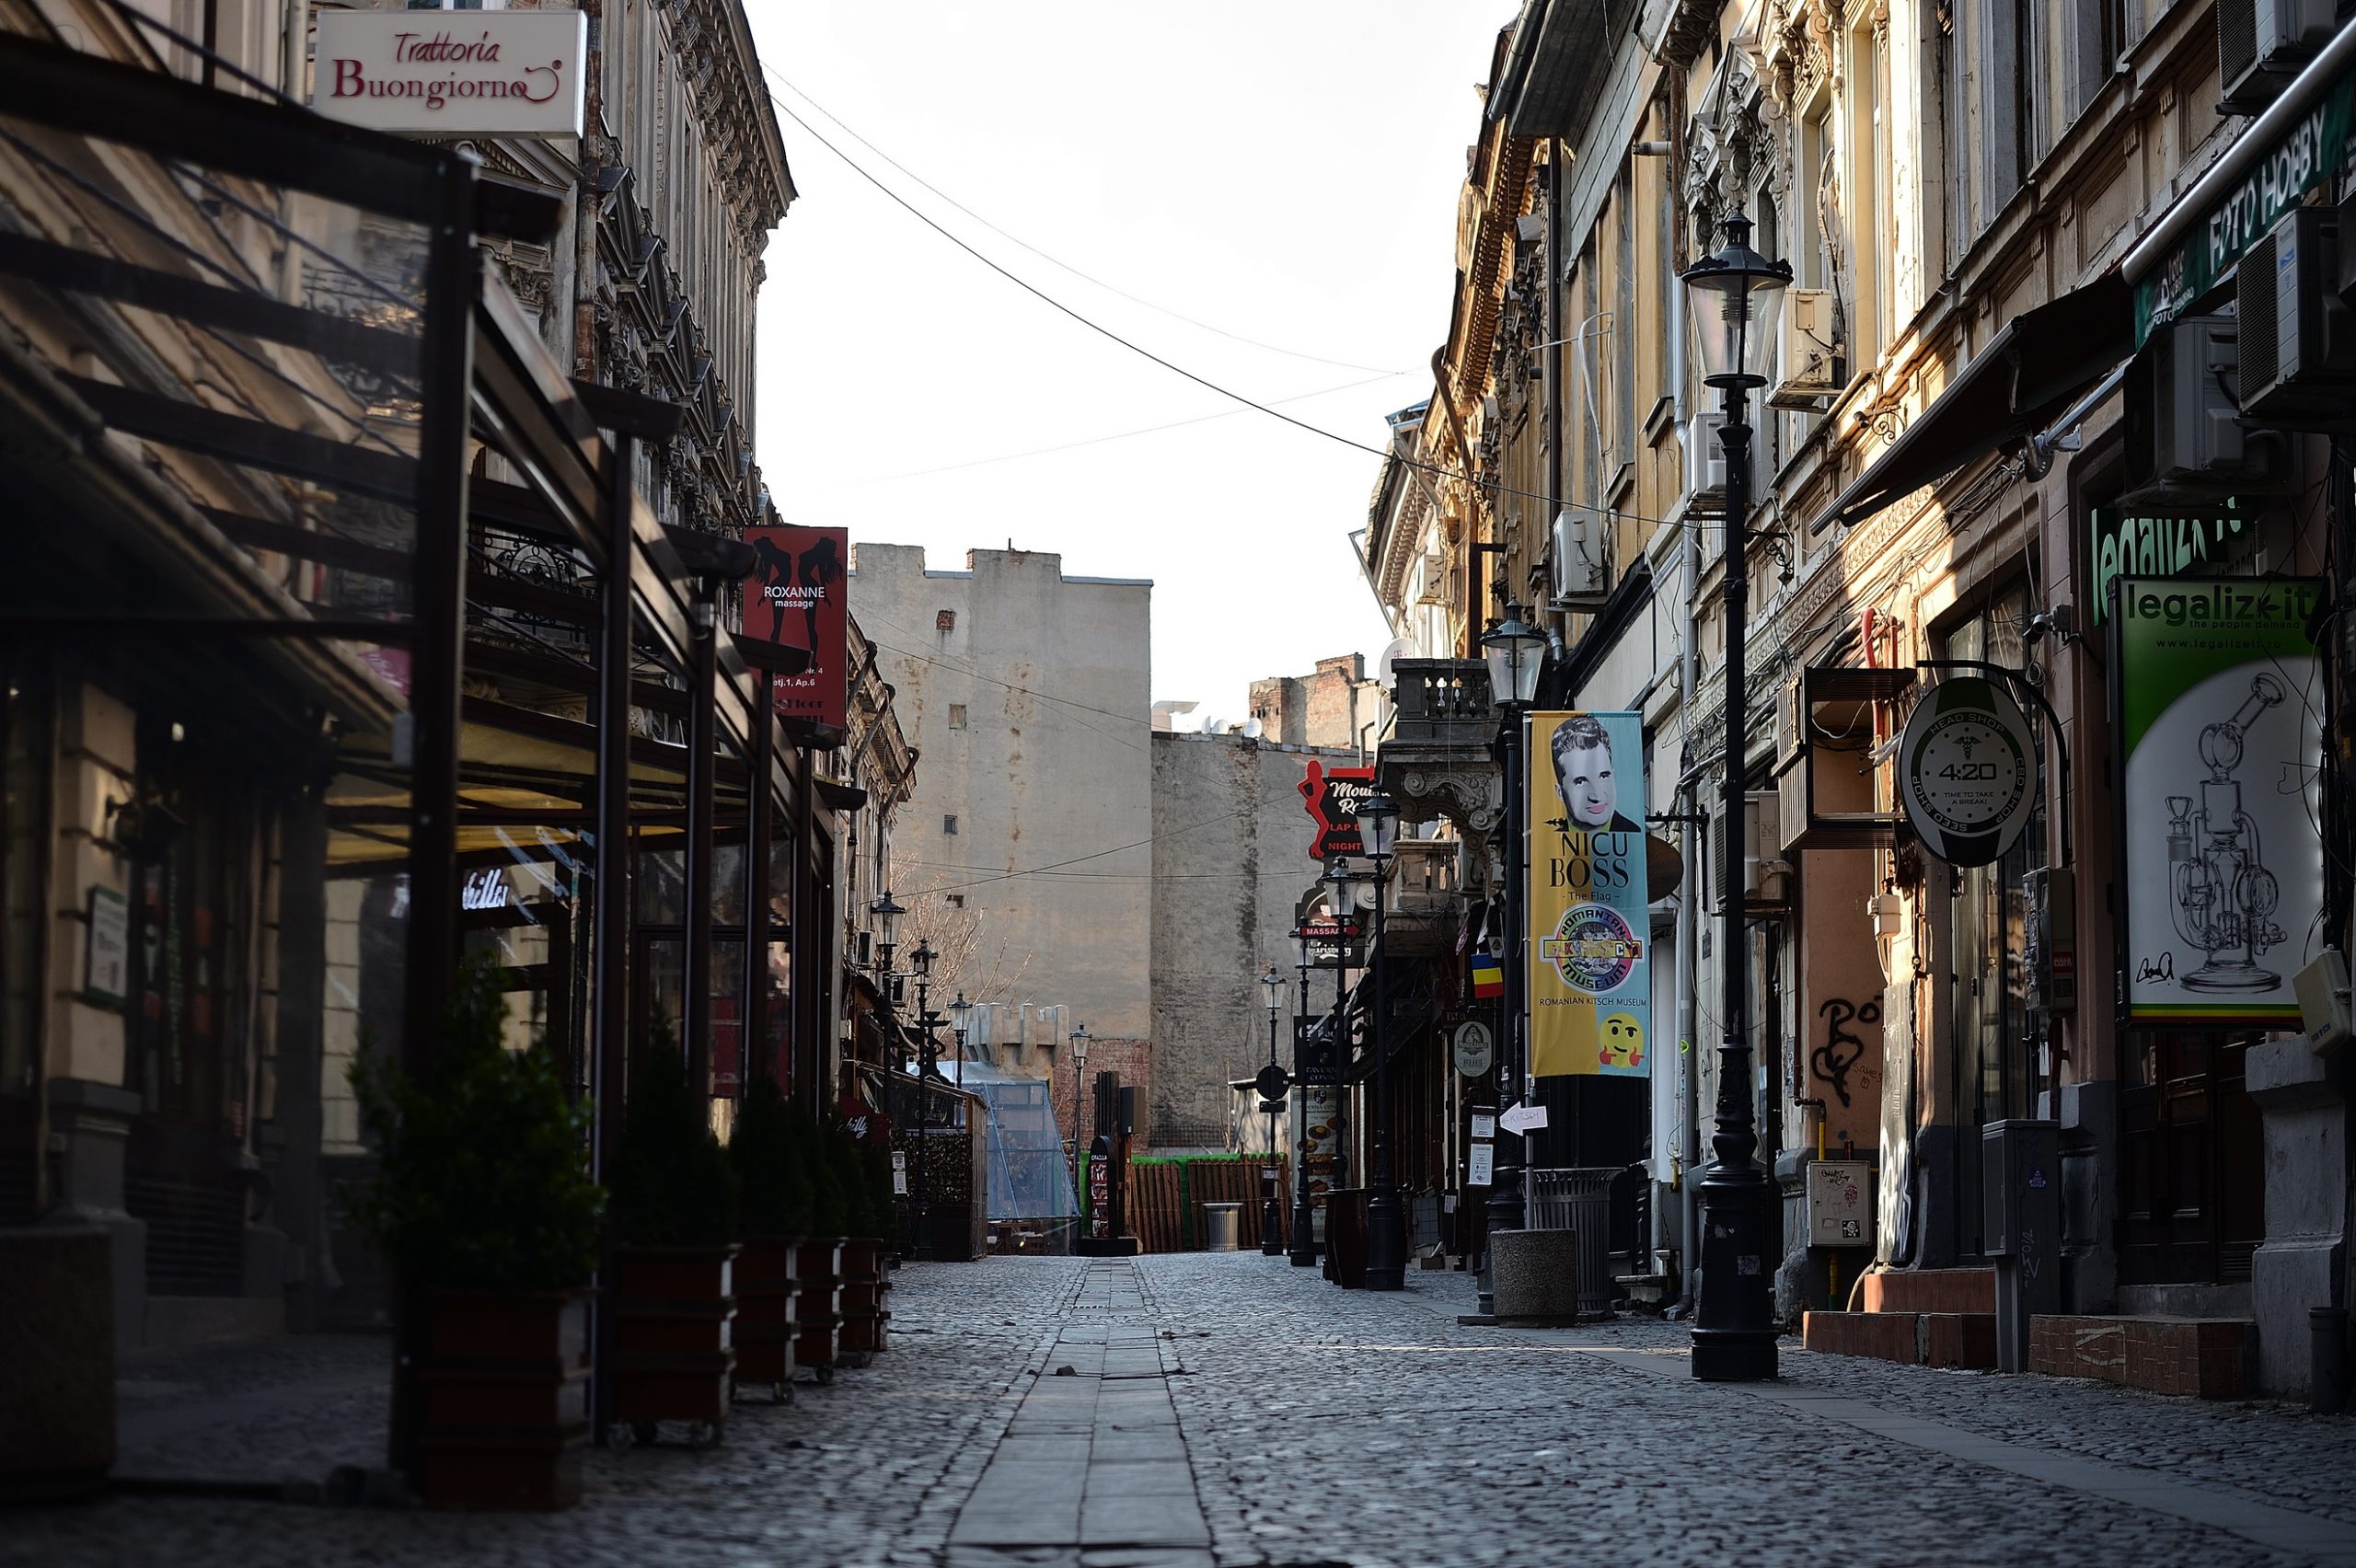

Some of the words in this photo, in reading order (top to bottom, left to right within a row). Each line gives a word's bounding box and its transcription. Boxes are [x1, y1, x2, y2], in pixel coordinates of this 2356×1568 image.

[395, 31, 501, 63] Trattoria
[330, 59, 531, 110] Buongiorno
[2209, 176, 2258, 276] FOTO
[2260, 102, 2327, 226] HOBBY
[764, 586, 825, 598] ROXANNE
[775, 600, 814, 609] massage
[2284, 586, 2314, 621] it
[2189, 620, 2207, 628] the
[2212, 620, 2251, 629] people
[2255, 620, 2300, 629] demand
[2156, 639, 2281, 650] www.legalizeit.ro
[795, 678, 815, 687] Ap.6
[1930, 713, 1965, 734] HEAD
[1969, 713, 2004, 732] SHOP
[1939, 763, 1997, 780] 4:20
[1911, 776, 1934, 813] SHOP
[1995, 790, 2022, 824] SHOP
[1330, 824, 1351, 832] LAP
[1934, 813, 1968, 833] SEED
[1328, 842, 1362, 851] NIGHT
[1561, 832, 1628, 857] NICU
[1550, 858, 1629, 888] BOSS
[1568, 892, 1588, 901] The
[1590, 892, 1611, 903] Flag
[1562, 909, 1626, 938] ROMANIAN
[1562, 963, 1626, 989] MUSEUM
[1540, 997, 1584, 1006] ROMANIAN
[1586, 997, 1614, 1006] KITSCH
[1616, 997, 1646, 1007] MUSEUM
